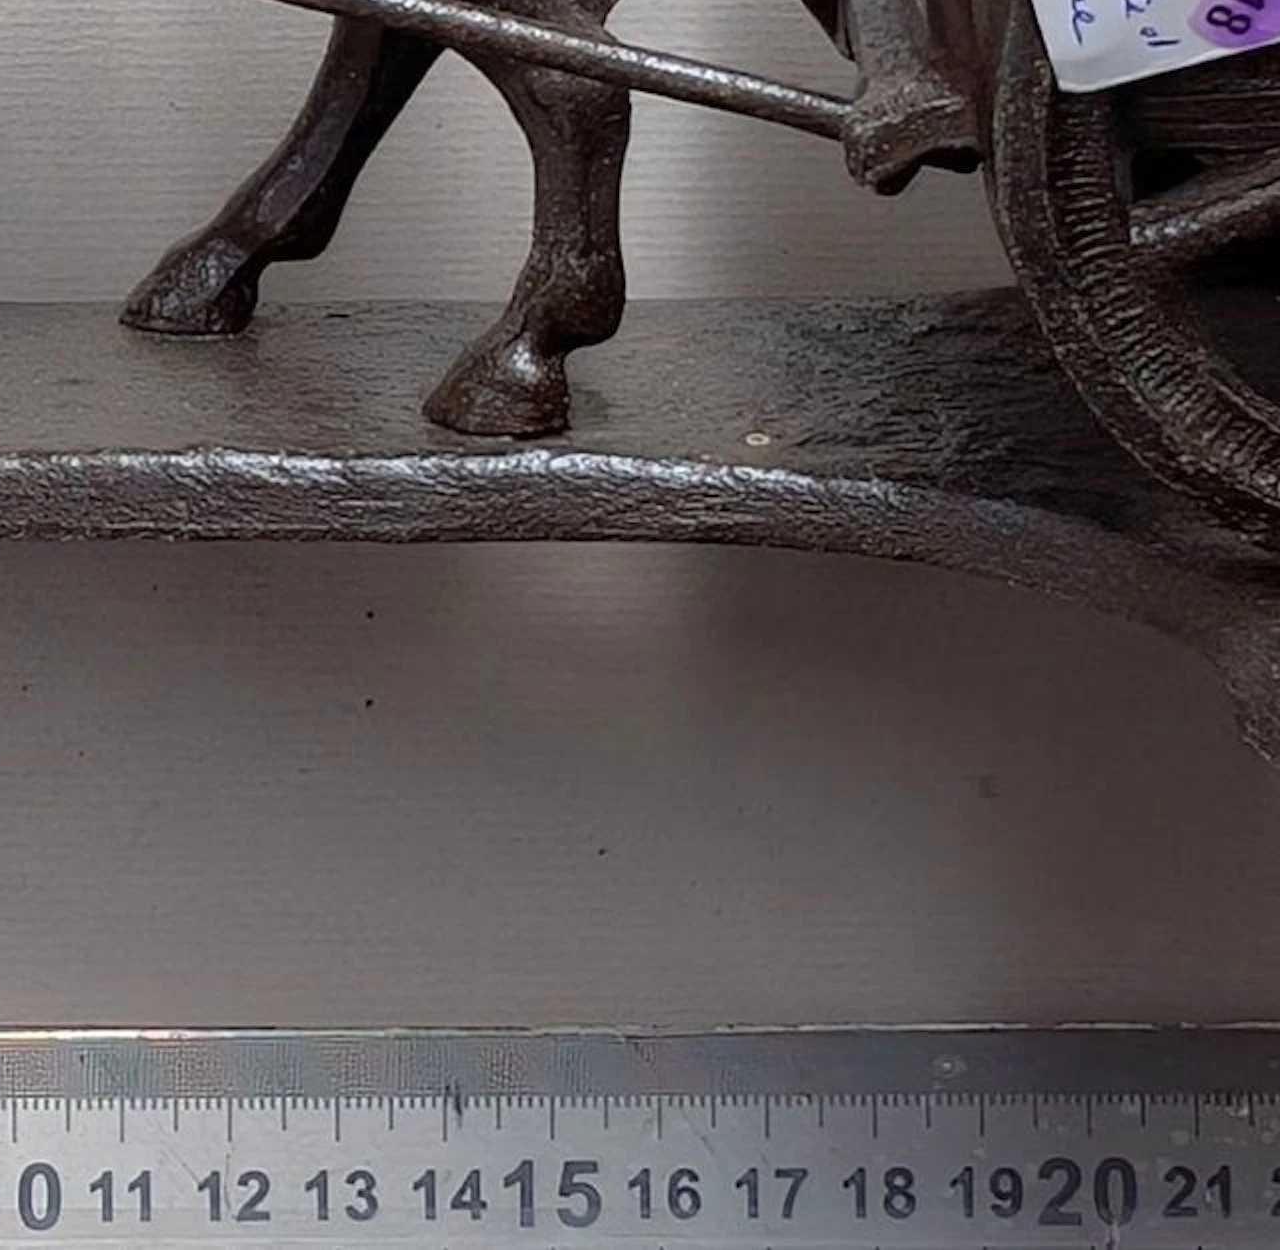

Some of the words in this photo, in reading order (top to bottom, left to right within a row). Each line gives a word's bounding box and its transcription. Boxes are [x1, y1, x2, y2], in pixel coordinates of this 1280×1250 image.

[90, 1173, 152, 1225] 11
[197, 1172, 271, 1225] 12
[305, 1172, 378, 1224] 13
[412, 1172, 487, 1224] 14
[504, 1162, 601, 1231] 15
[628, 1171, 701, 1223] 16
[735, 1171, 809, 1223] 17
[843, 1170, 916, 1223] 18
[949, 1170, 1023, 1223] 19
[1039, 1161, 1137, 1229] 20
[1163, 1169, 1232, 1222] 21
